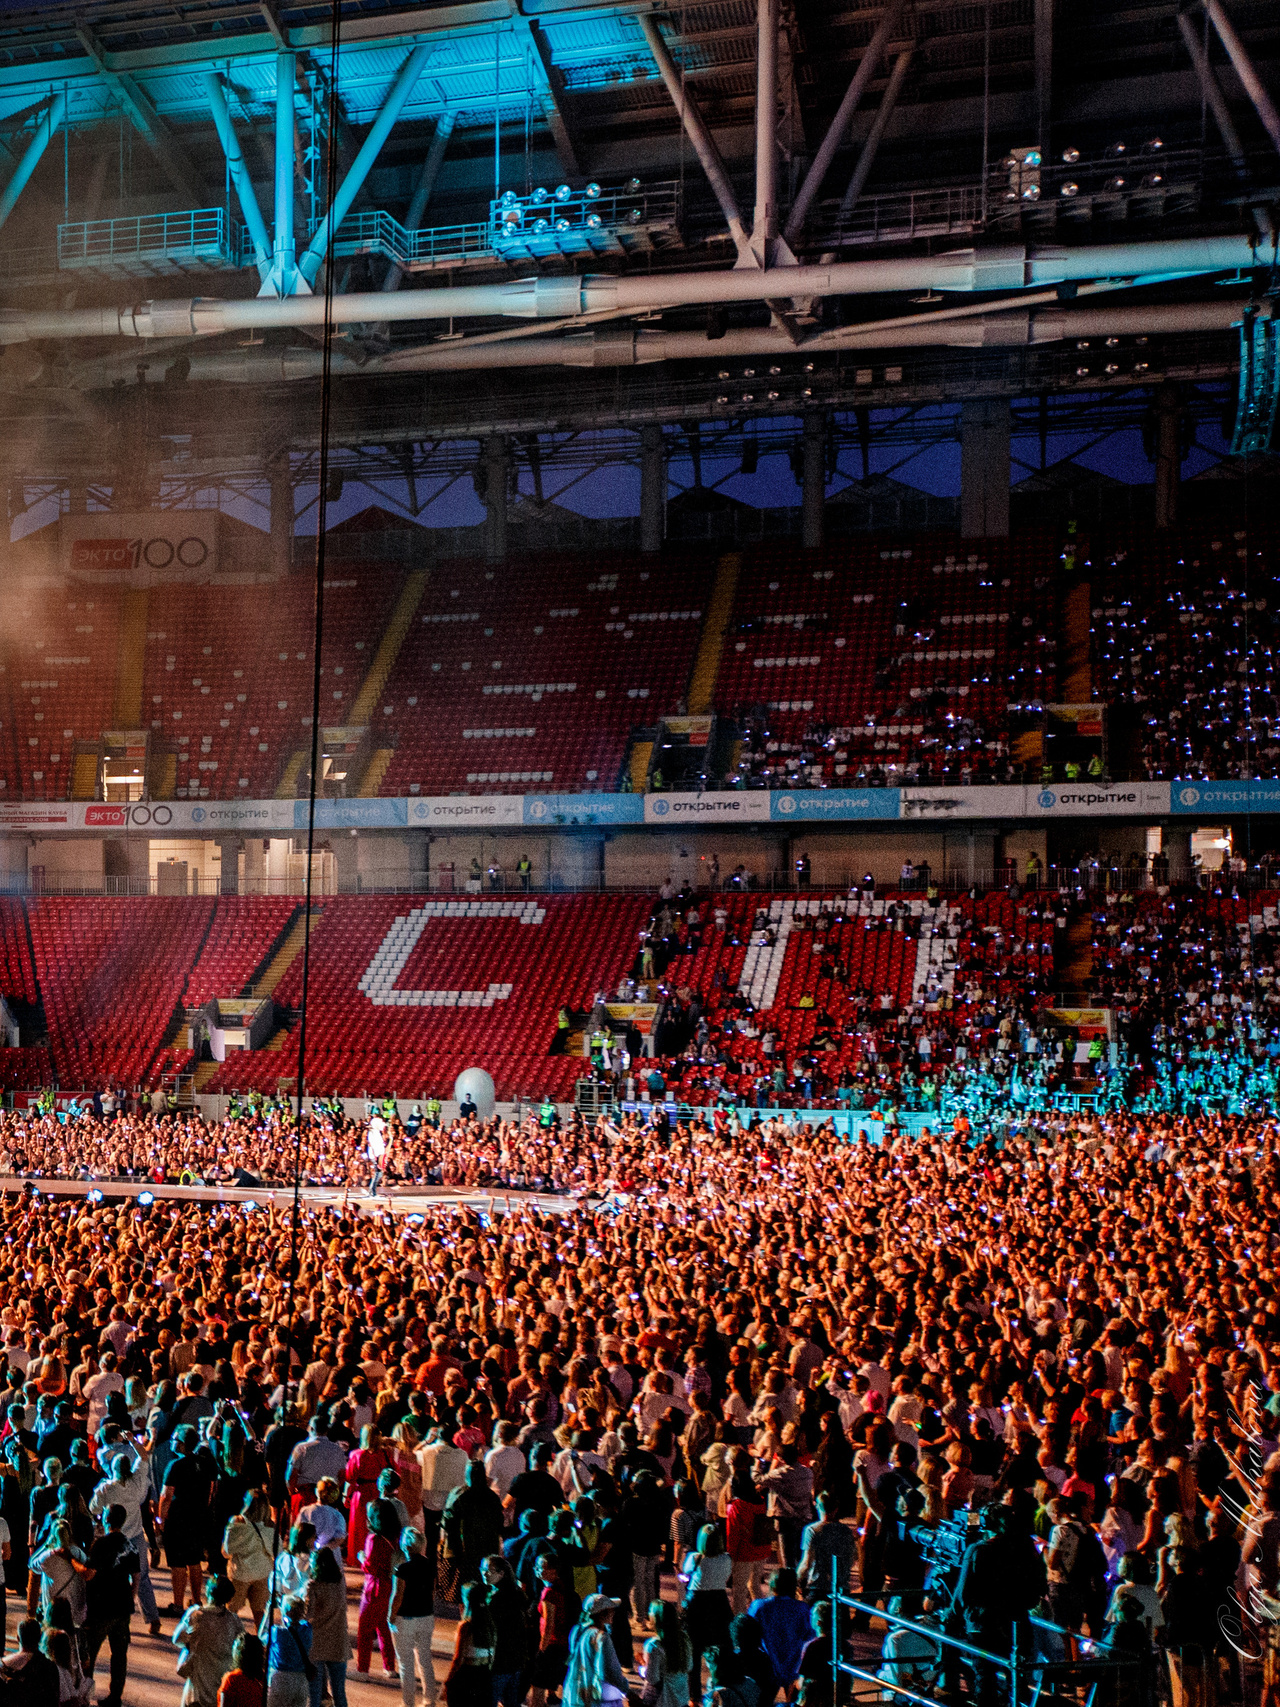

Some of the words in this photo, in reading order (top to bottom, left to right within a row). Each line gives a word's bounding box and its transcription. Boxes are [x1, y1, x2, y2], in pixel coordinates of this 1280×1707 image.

[1060, 791, 1137, 804] открытие
[433, 804, 497, 816] открытие
[673, 800, 740, 812] открытие
[799, 798, 869, 811] открытие
[209, 807, 269, 820] открытие
